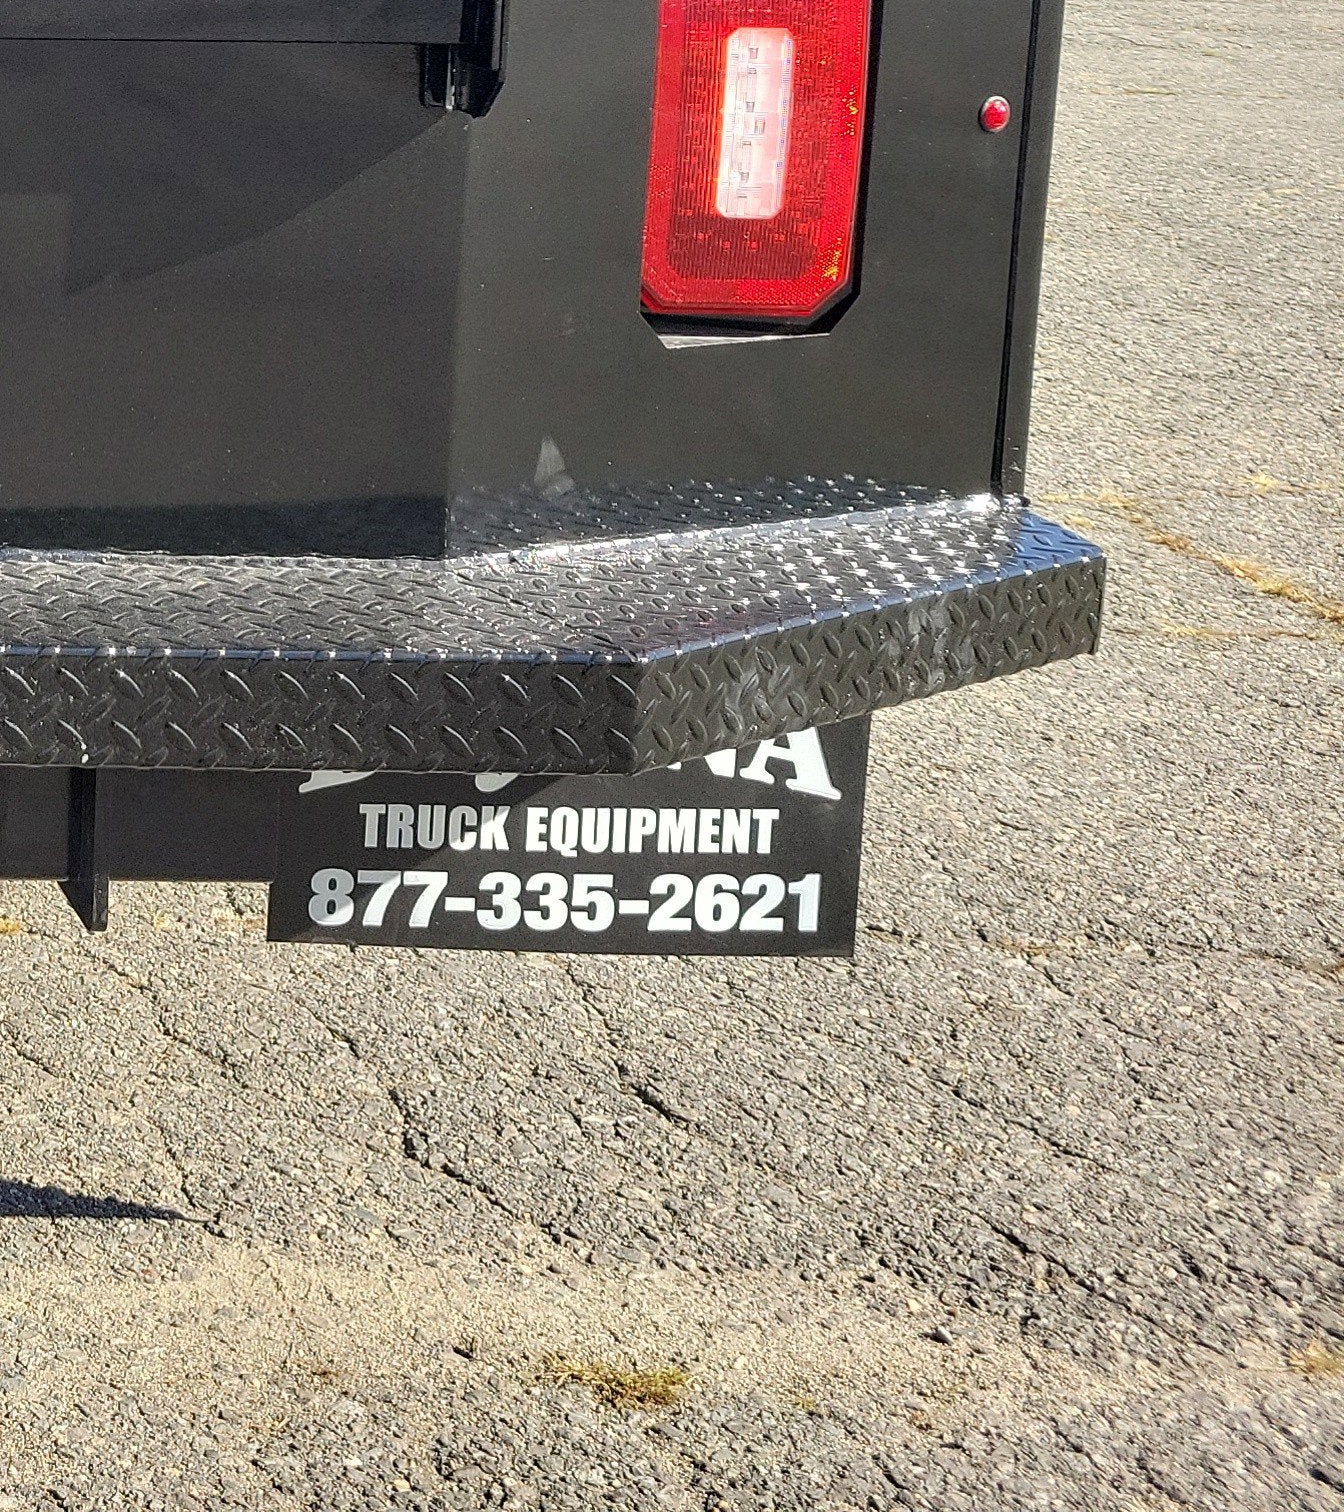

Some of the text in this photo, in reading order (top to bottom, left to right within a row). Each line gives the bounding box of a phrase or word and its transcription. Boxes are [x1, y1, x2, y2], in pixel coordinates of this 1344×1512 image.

[359, 803, 780, 858] TRUCK EQUIPMENT
[308, 868, 822, 935] 877-335-2621
